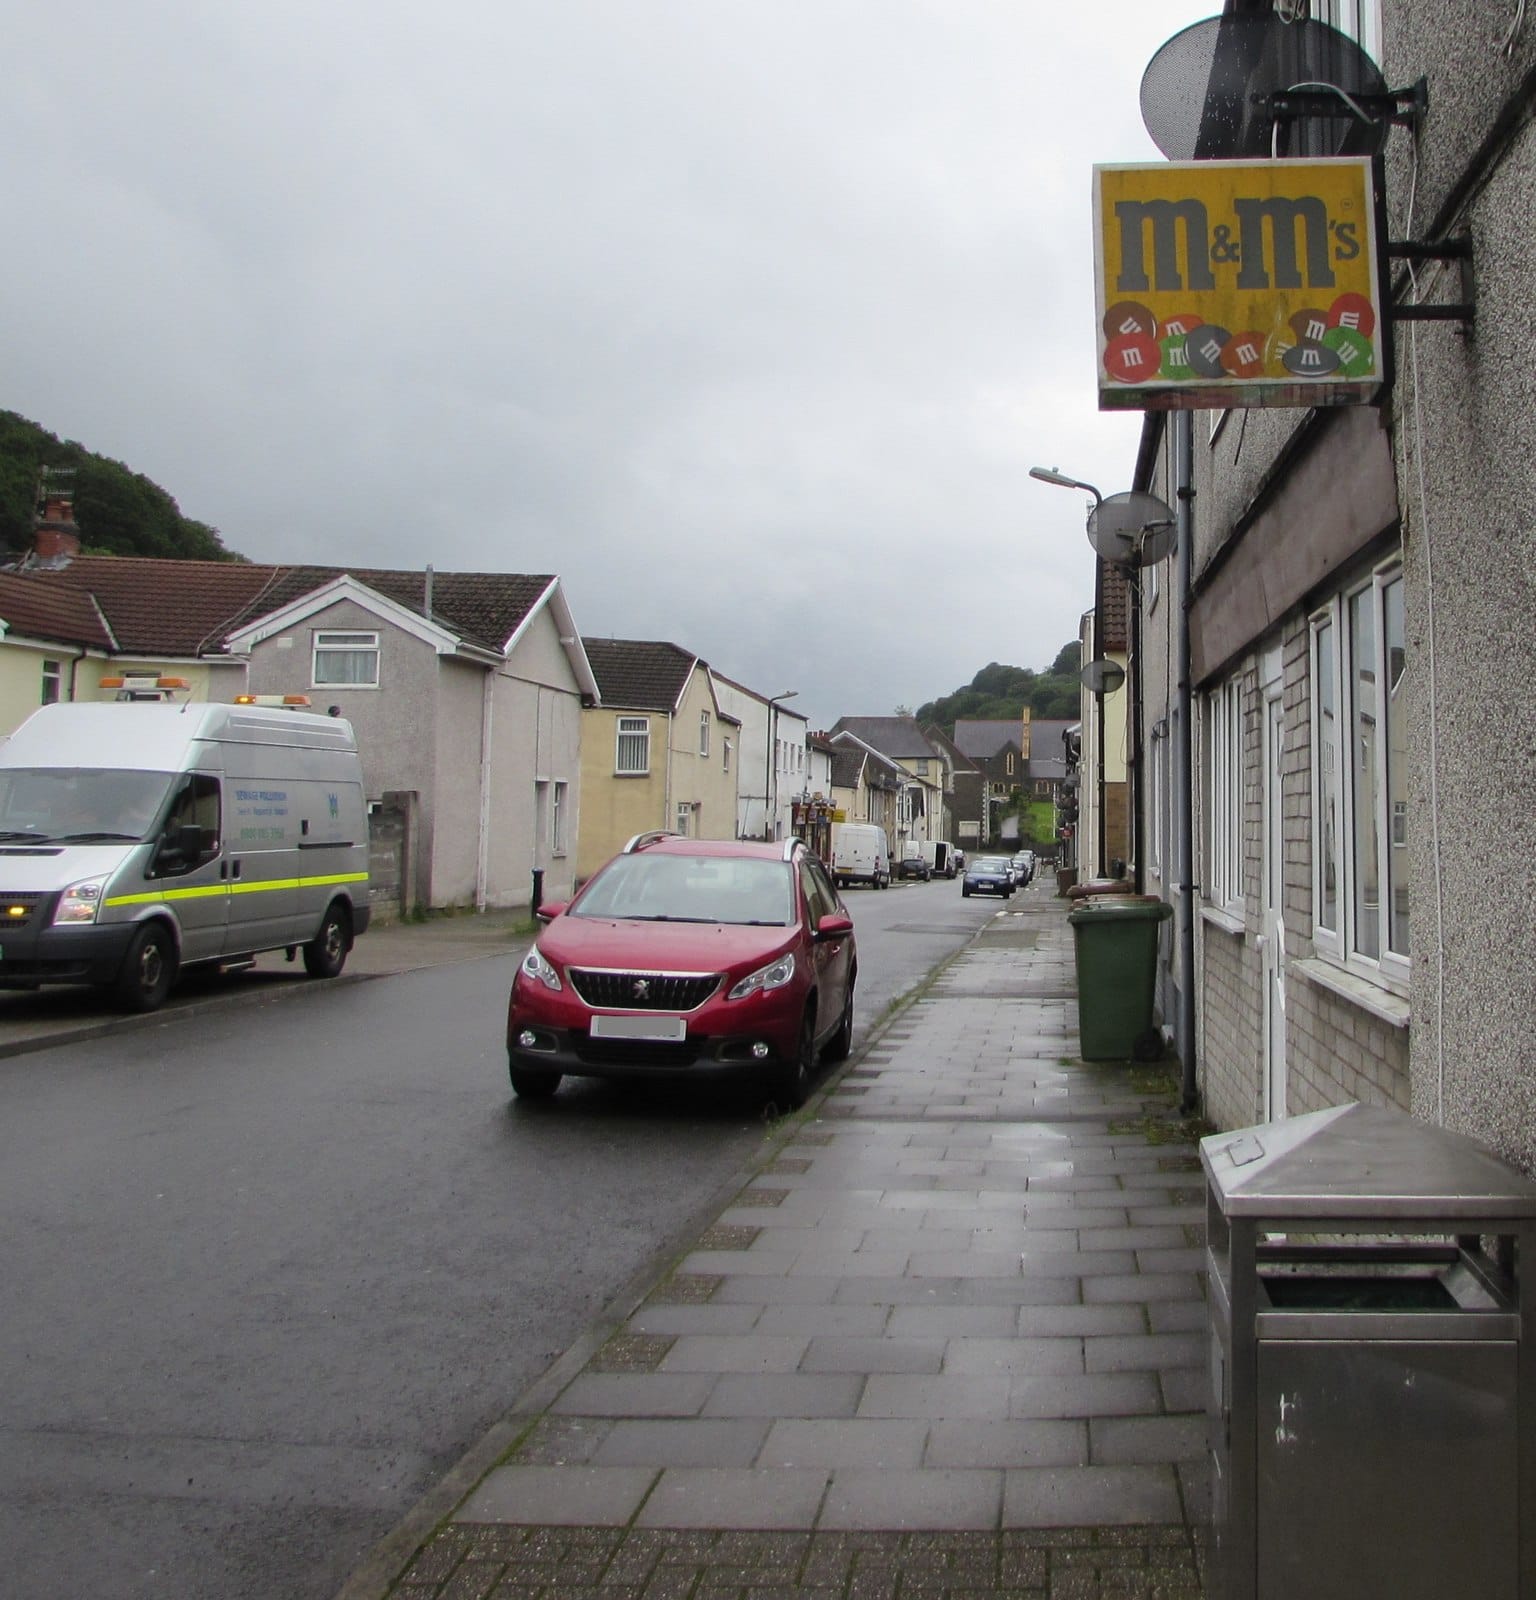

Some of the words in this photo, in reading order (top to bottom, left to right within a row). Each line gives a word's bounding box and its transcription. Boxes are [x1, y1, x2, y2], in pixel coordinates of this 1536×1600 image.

[1304, 319, 1326, 342] m
[1122, 347, 1144, 369] m
[1235, 343, 1259, 366] m
[1300, 348, 1321, 366] m
